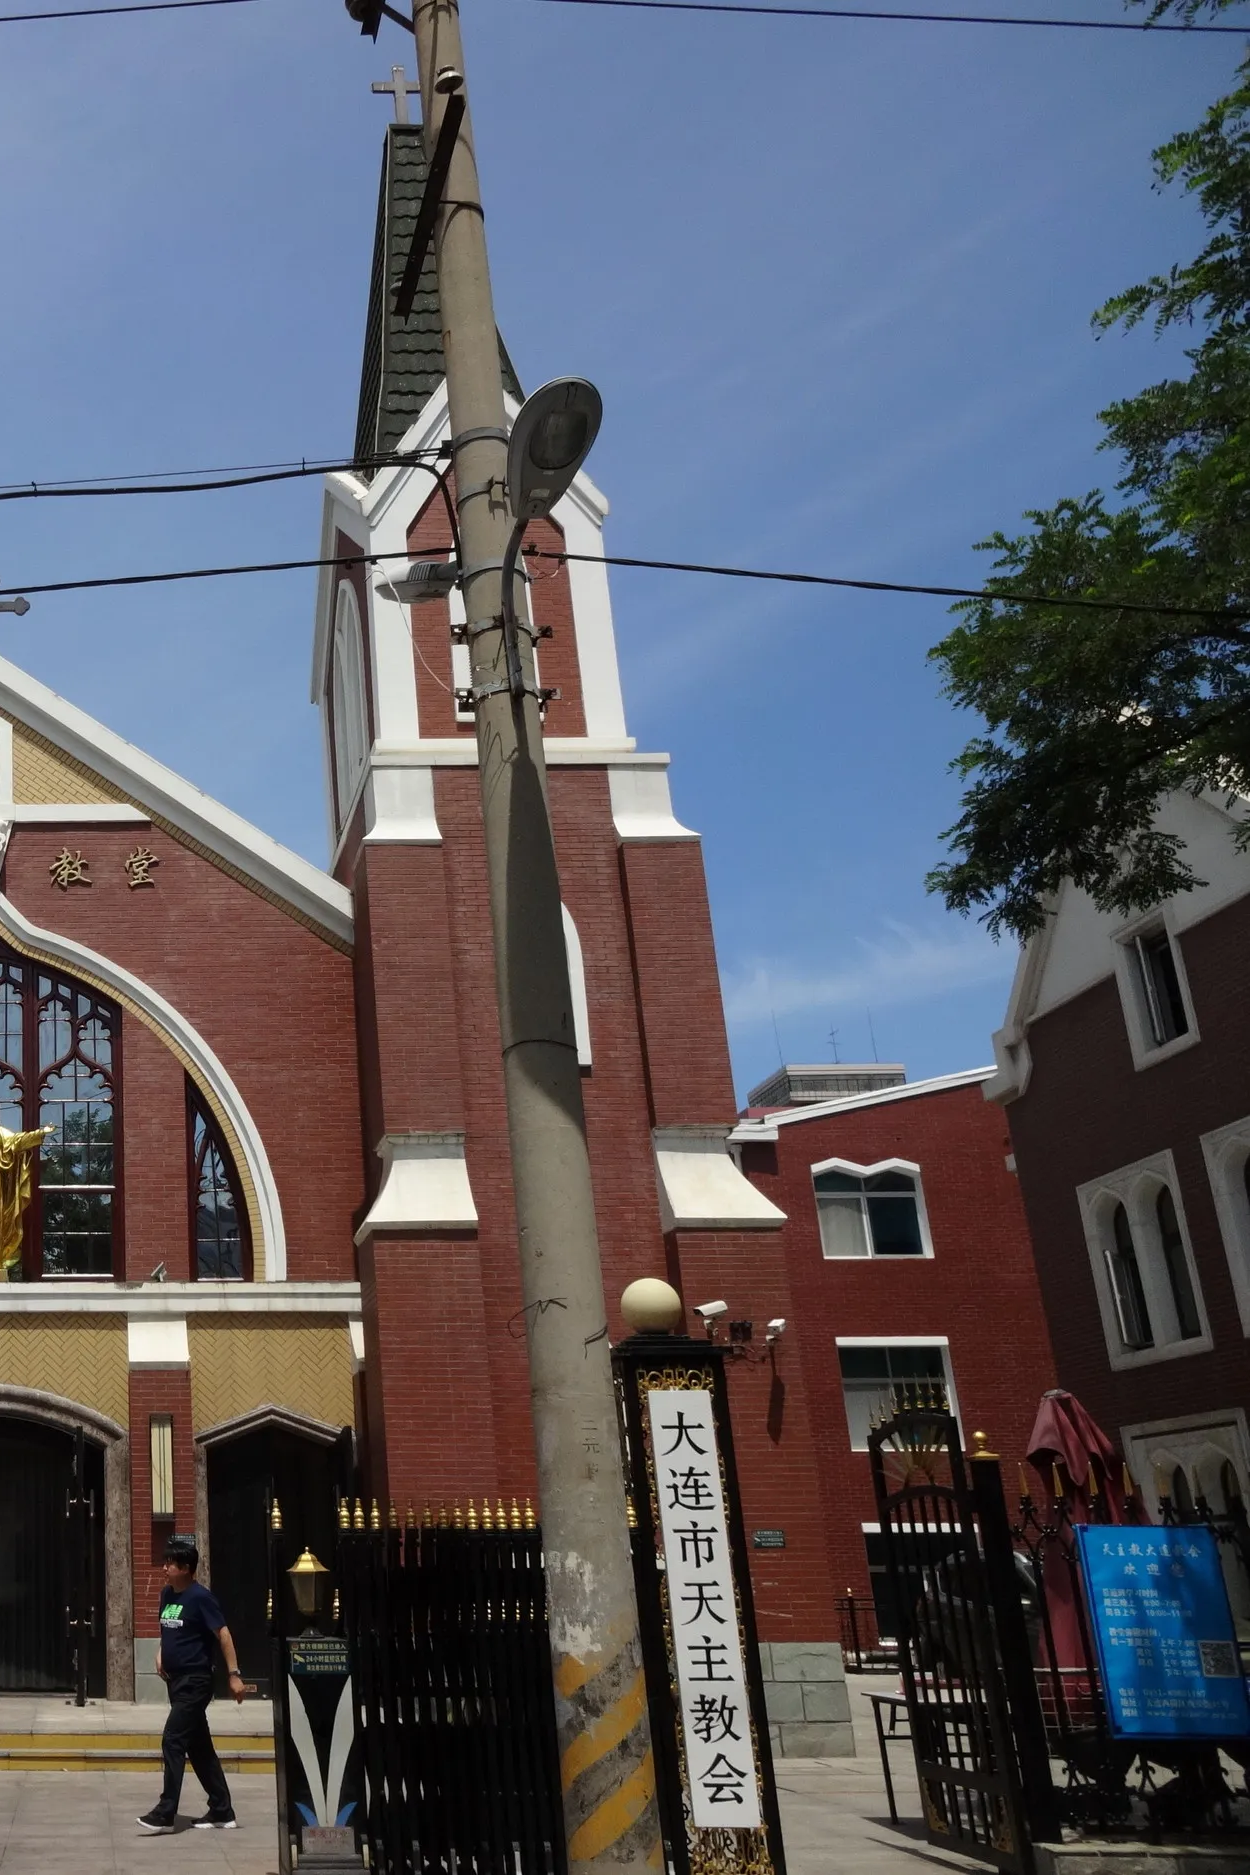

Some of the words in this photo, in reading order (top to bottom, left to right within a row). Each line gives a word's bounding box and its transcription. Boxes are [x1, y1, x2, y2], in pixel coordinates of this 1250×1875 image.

[660, 1410, 749, 1806] 大连市天主教会
